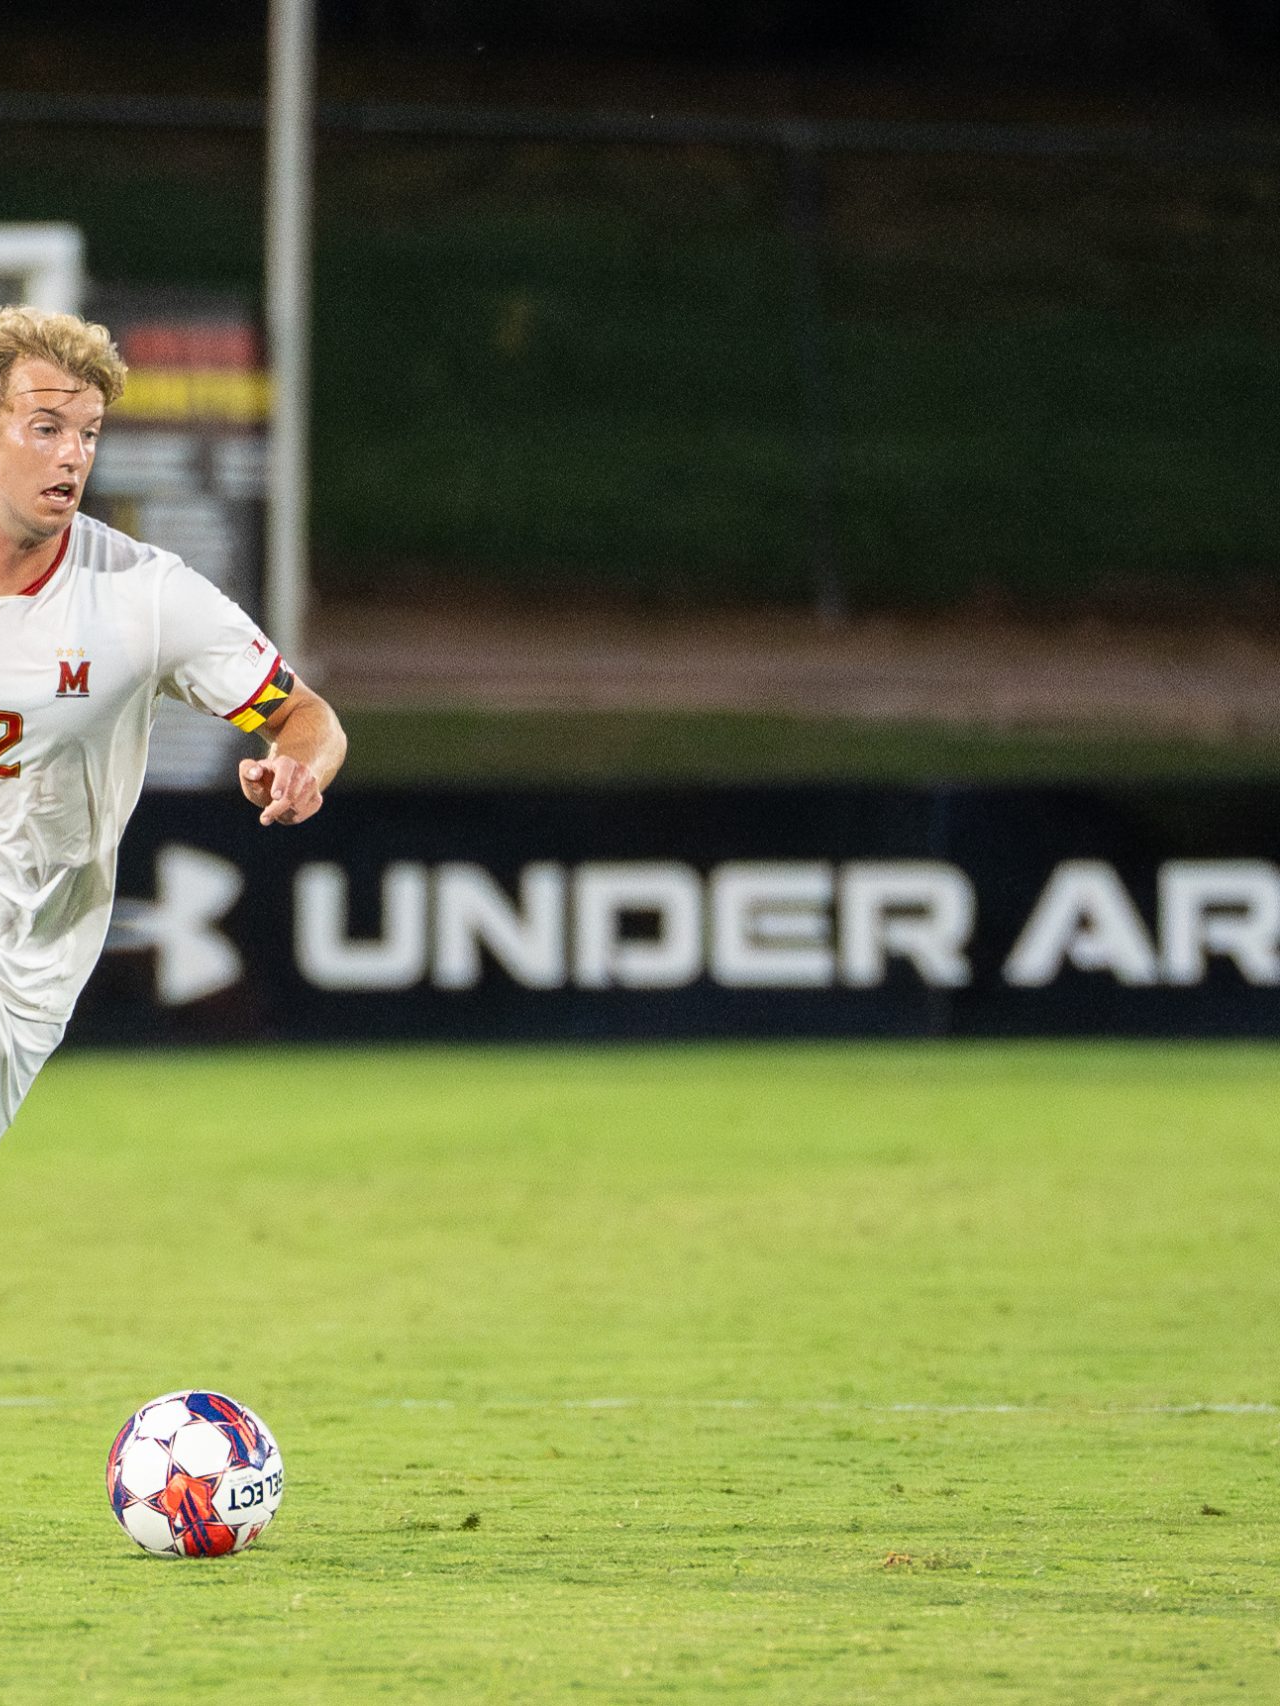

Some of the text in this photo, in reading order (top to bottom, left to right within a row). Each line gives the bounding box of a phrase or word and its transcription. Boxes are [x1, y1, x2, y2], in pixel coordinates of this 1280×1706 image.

[56, 660, 91, 693] M
[295, 860, 1280, 988] UNDER AR
